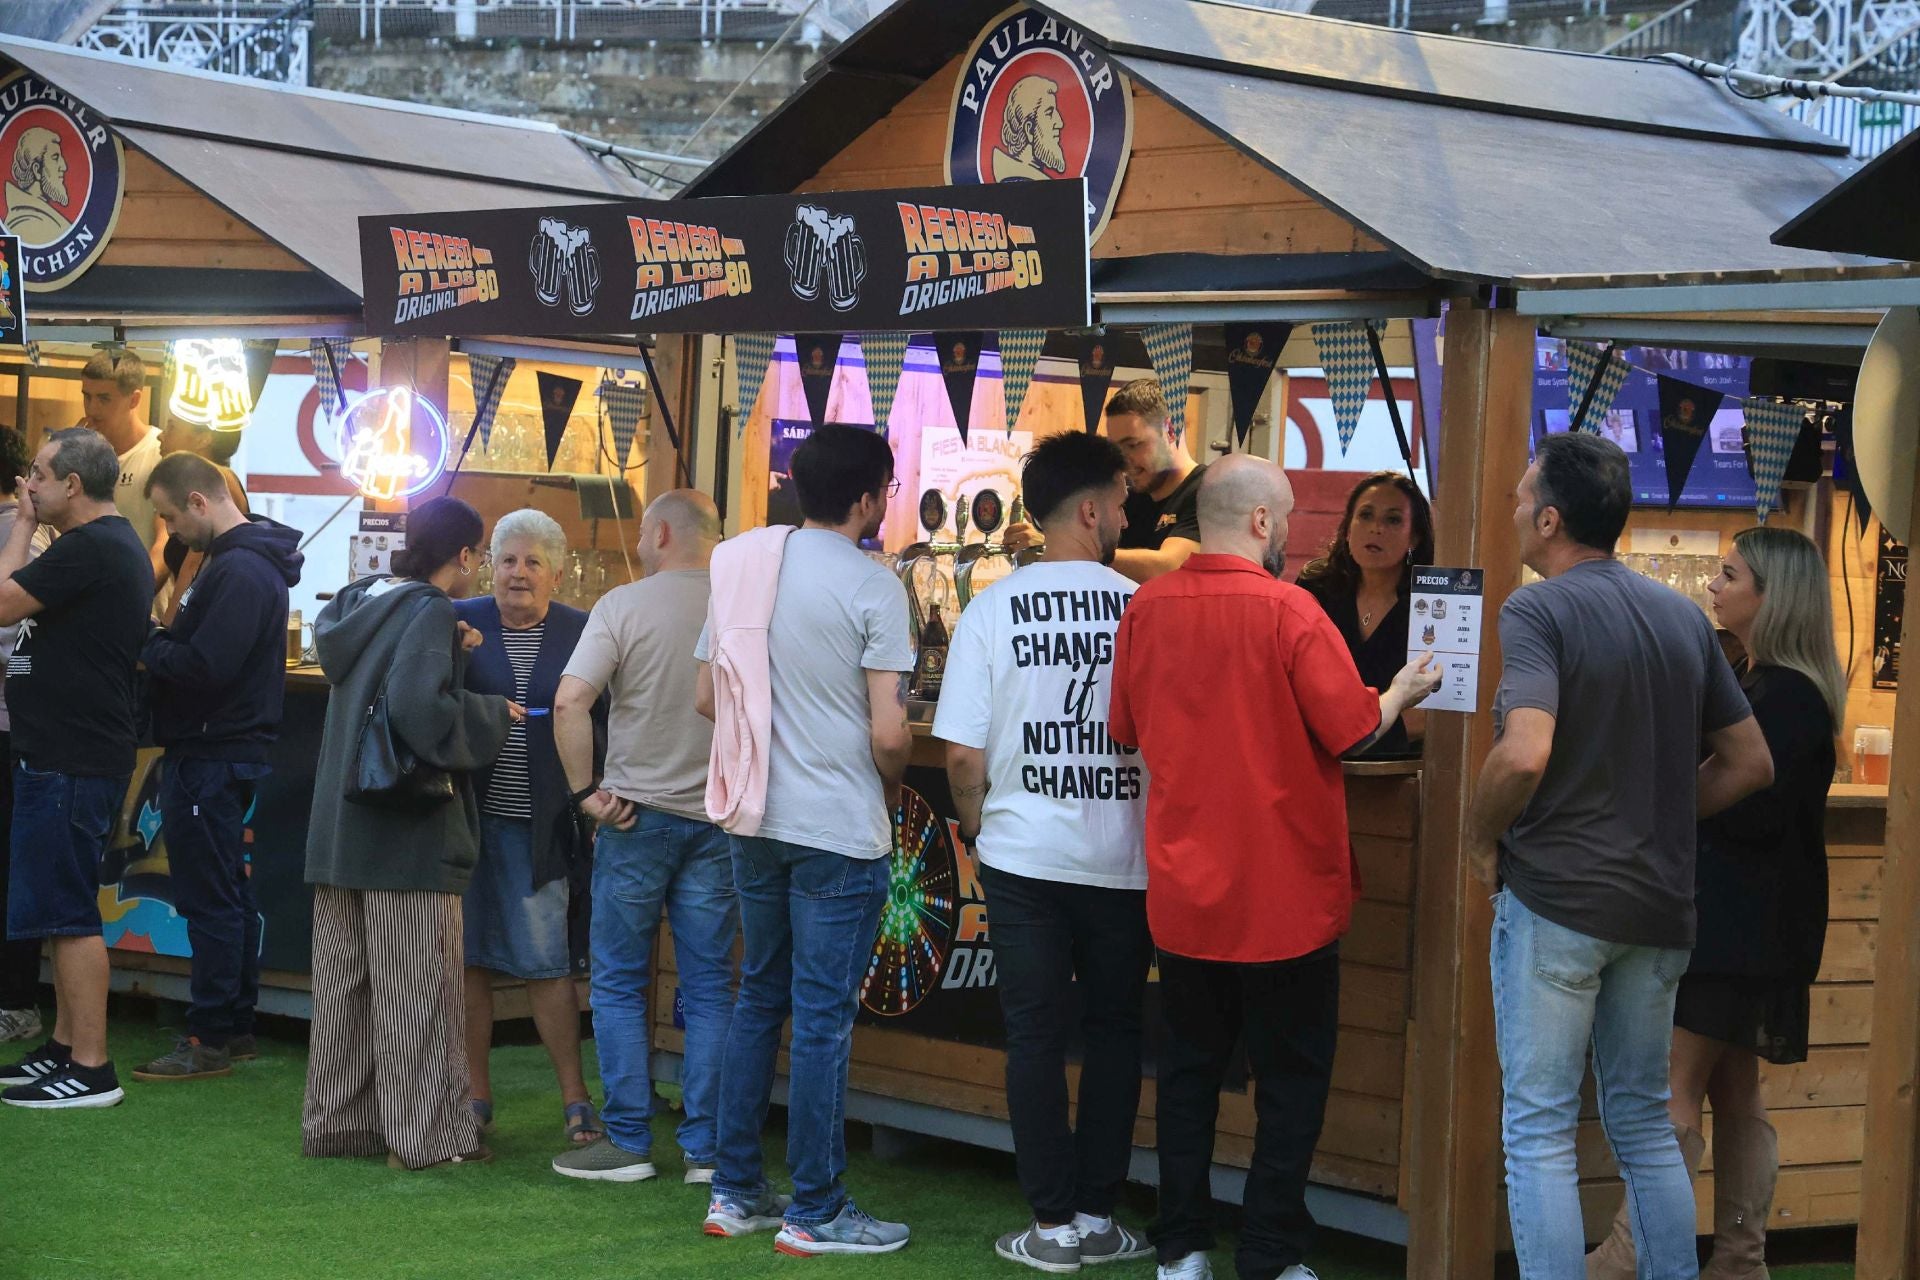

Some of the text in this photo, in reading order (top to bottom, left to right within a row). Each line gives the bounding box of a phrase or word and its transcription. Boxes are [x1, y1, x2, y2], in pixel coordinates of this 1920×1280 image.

[962, 15, 1114, 115] PAULANER
[0, 79, 107, 152] ULAR
[626, 215, 722, 263] REGRESO
[896, 201, 1008, 253] REGRESO
[389, 226, 474, 271] REGRESO
[398, 269, 499, 303] A LOS 80
[636, 260, 752, 297] A LOS 80
[906, 250, 1043, 290] A LOS 80
[394, 290, 457, 325] ORIGINAL
[630, 283, 703, 321] ORIGINAL
[899, 274, 985, 316] ORIGINAL
[977, 435, 1021, 460] BLANCA
[362, 518, 390, 526] PRECIOS
[1416, 575, 1449, 586] PRECIOS
[1010, 590, 1133, 625] NOTHIN
[1011, 632, 1117, 668] CHANG
[1064, 653, 1099, 726] if
[1021, 764, 1141, 801] CHANGES
[941, 947, 997, 990] OR
